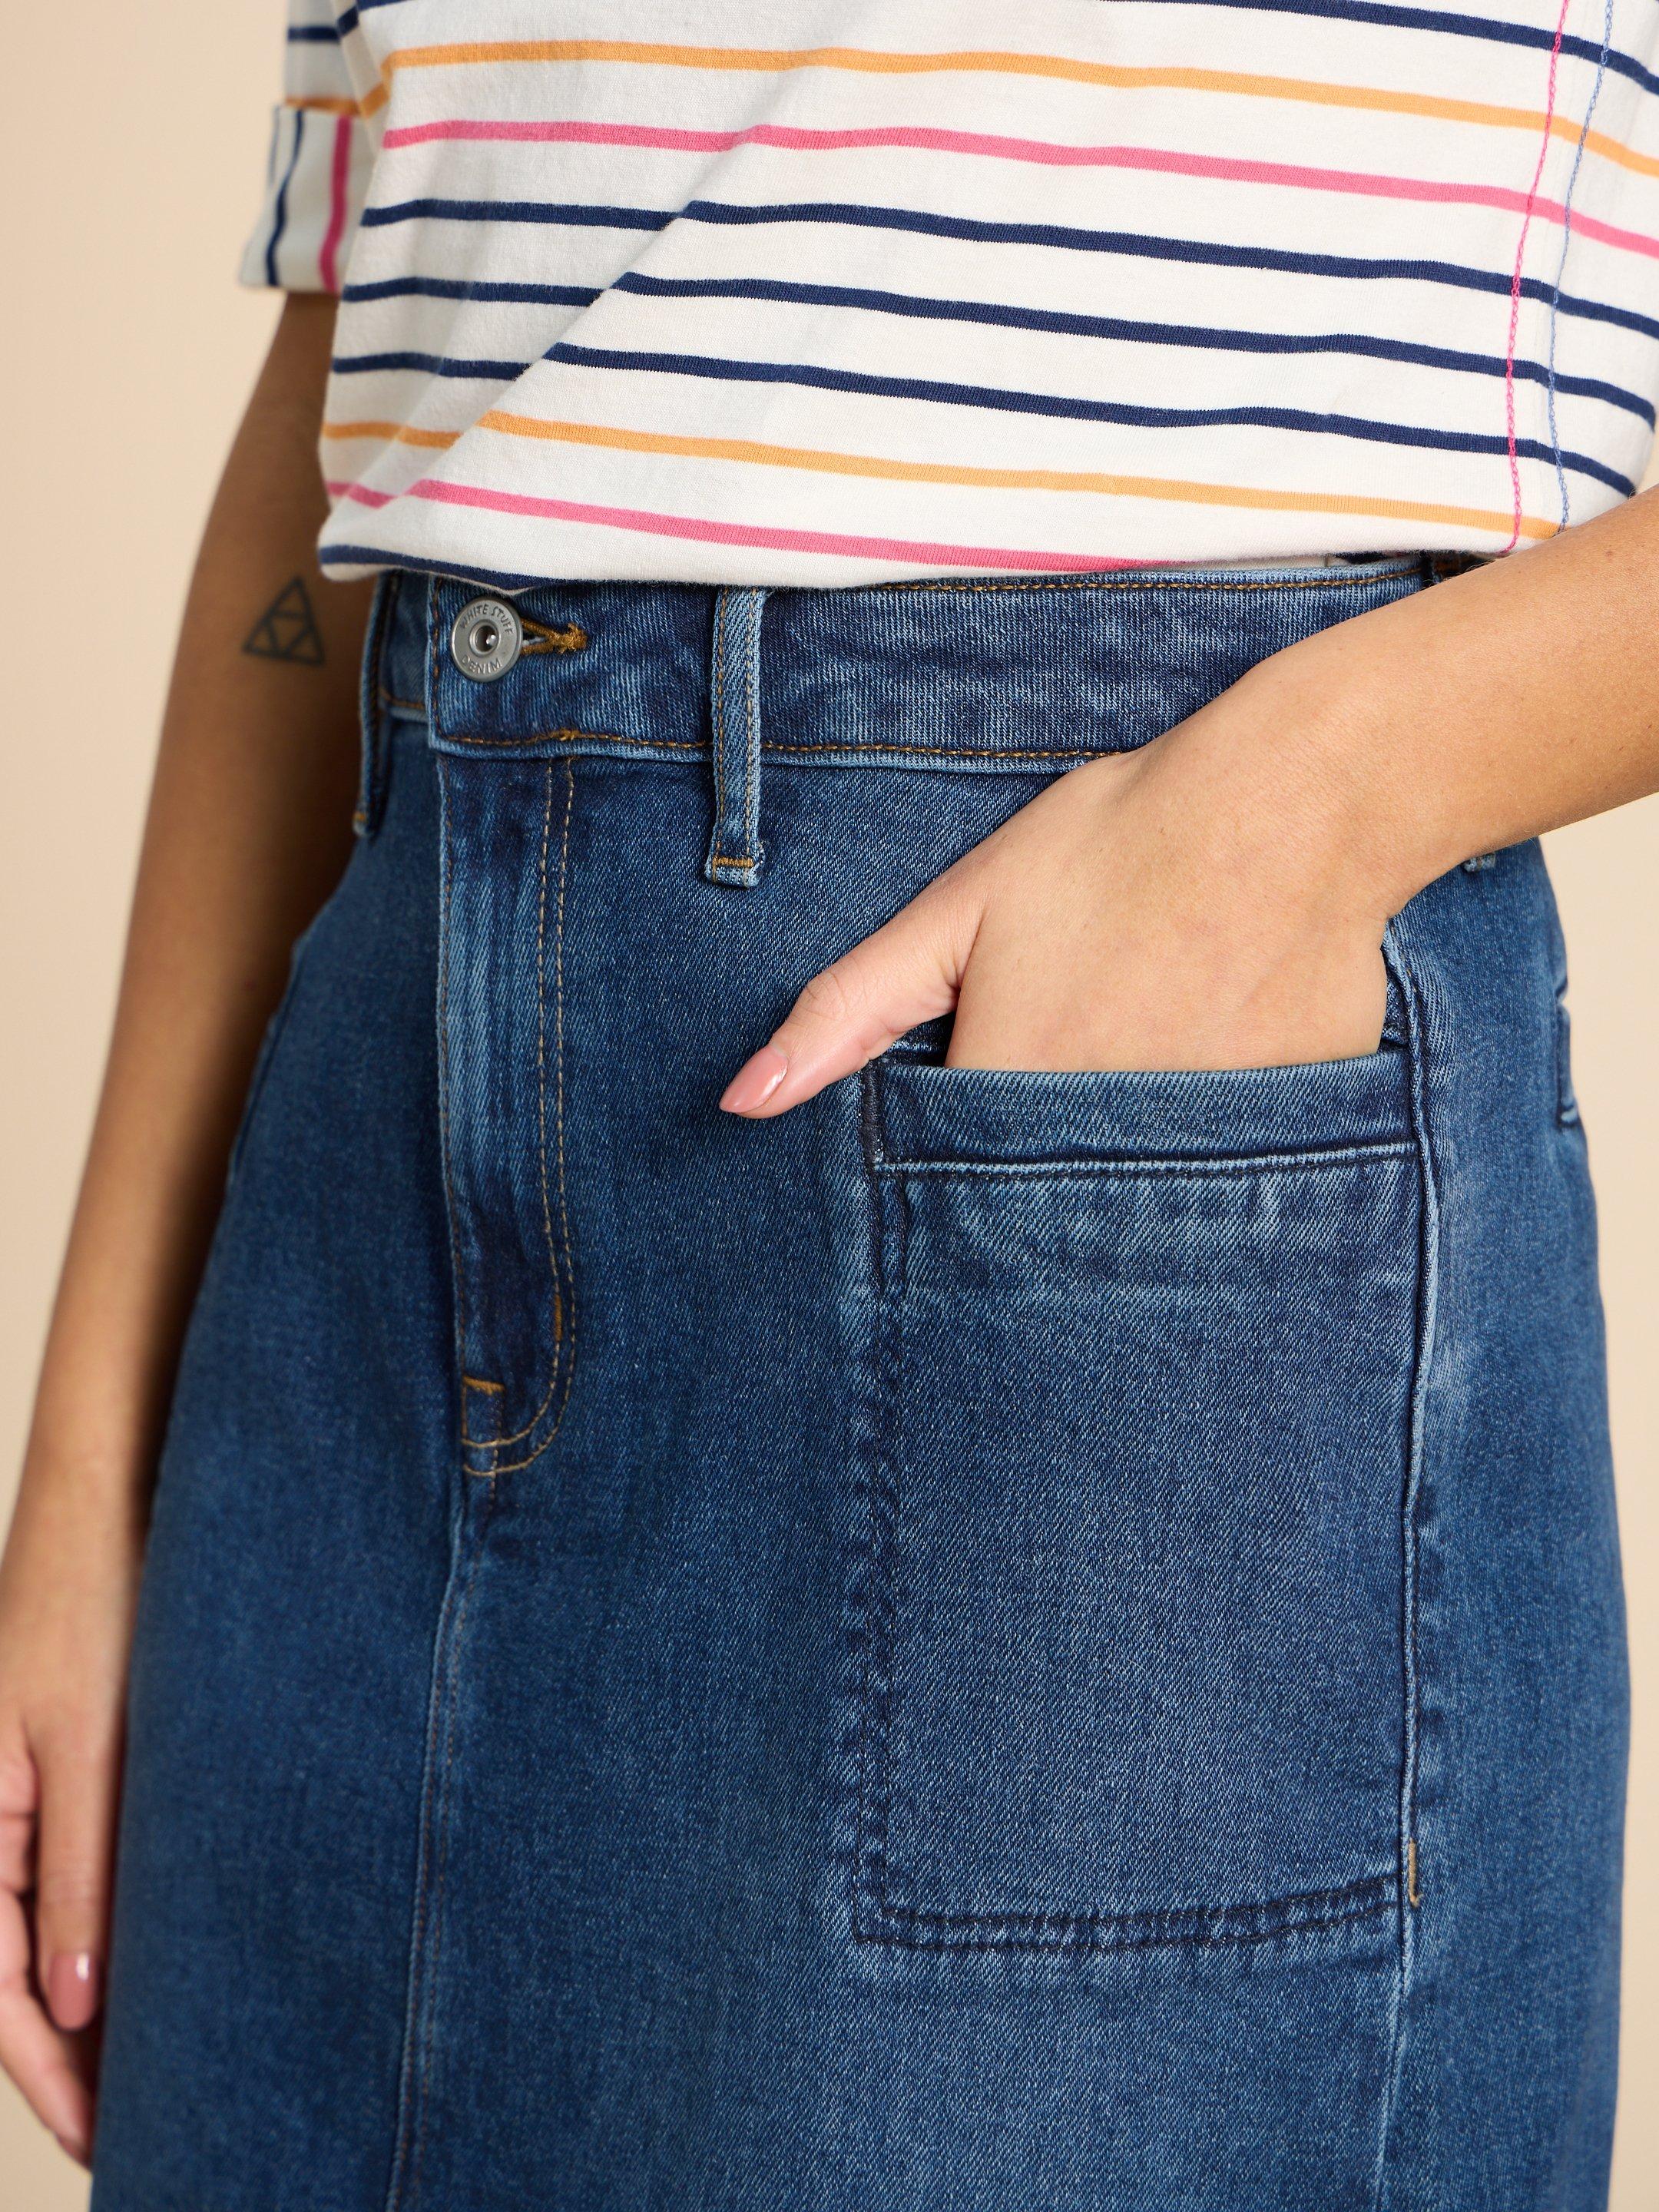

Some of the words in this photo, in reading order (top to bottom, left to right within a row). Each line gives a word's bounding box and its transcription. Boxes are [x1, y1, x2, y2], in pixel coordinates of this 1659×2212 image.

[460, 603, 489, 629] WHITE
[492, 606, 514, 634] STUFF
[462, 654, 503, 674] DENIM
